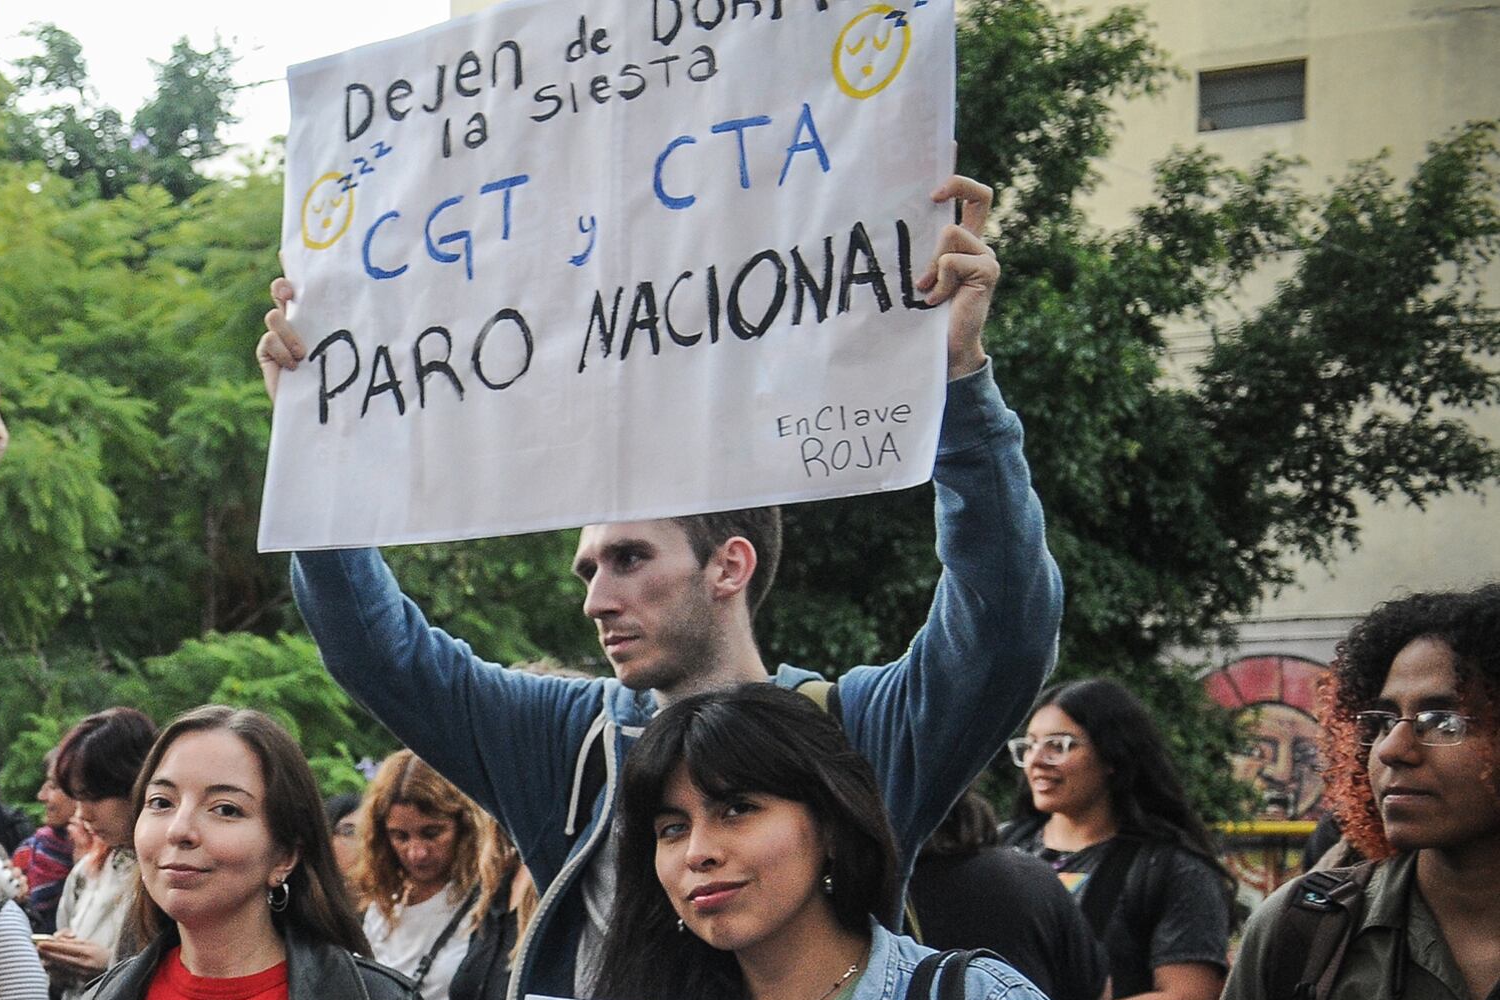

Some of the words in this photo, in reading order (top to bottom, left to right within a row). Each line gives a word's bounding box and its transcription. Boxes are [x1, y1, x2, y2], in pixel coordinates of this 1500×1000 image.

[344, 41, 522, 142] Dejen
[566, 15, 611, 63] de
[443, 118, 489, 158] la
[362, 174, 530, 280] CGT
[568, 212, 598, 267] y
[652, 103, 831, 210] CTA
[308, 307, 534, 425] PARO
[577, 219, 940, 373] NACIONAL
[800, 432, 902, 478] ROJA
